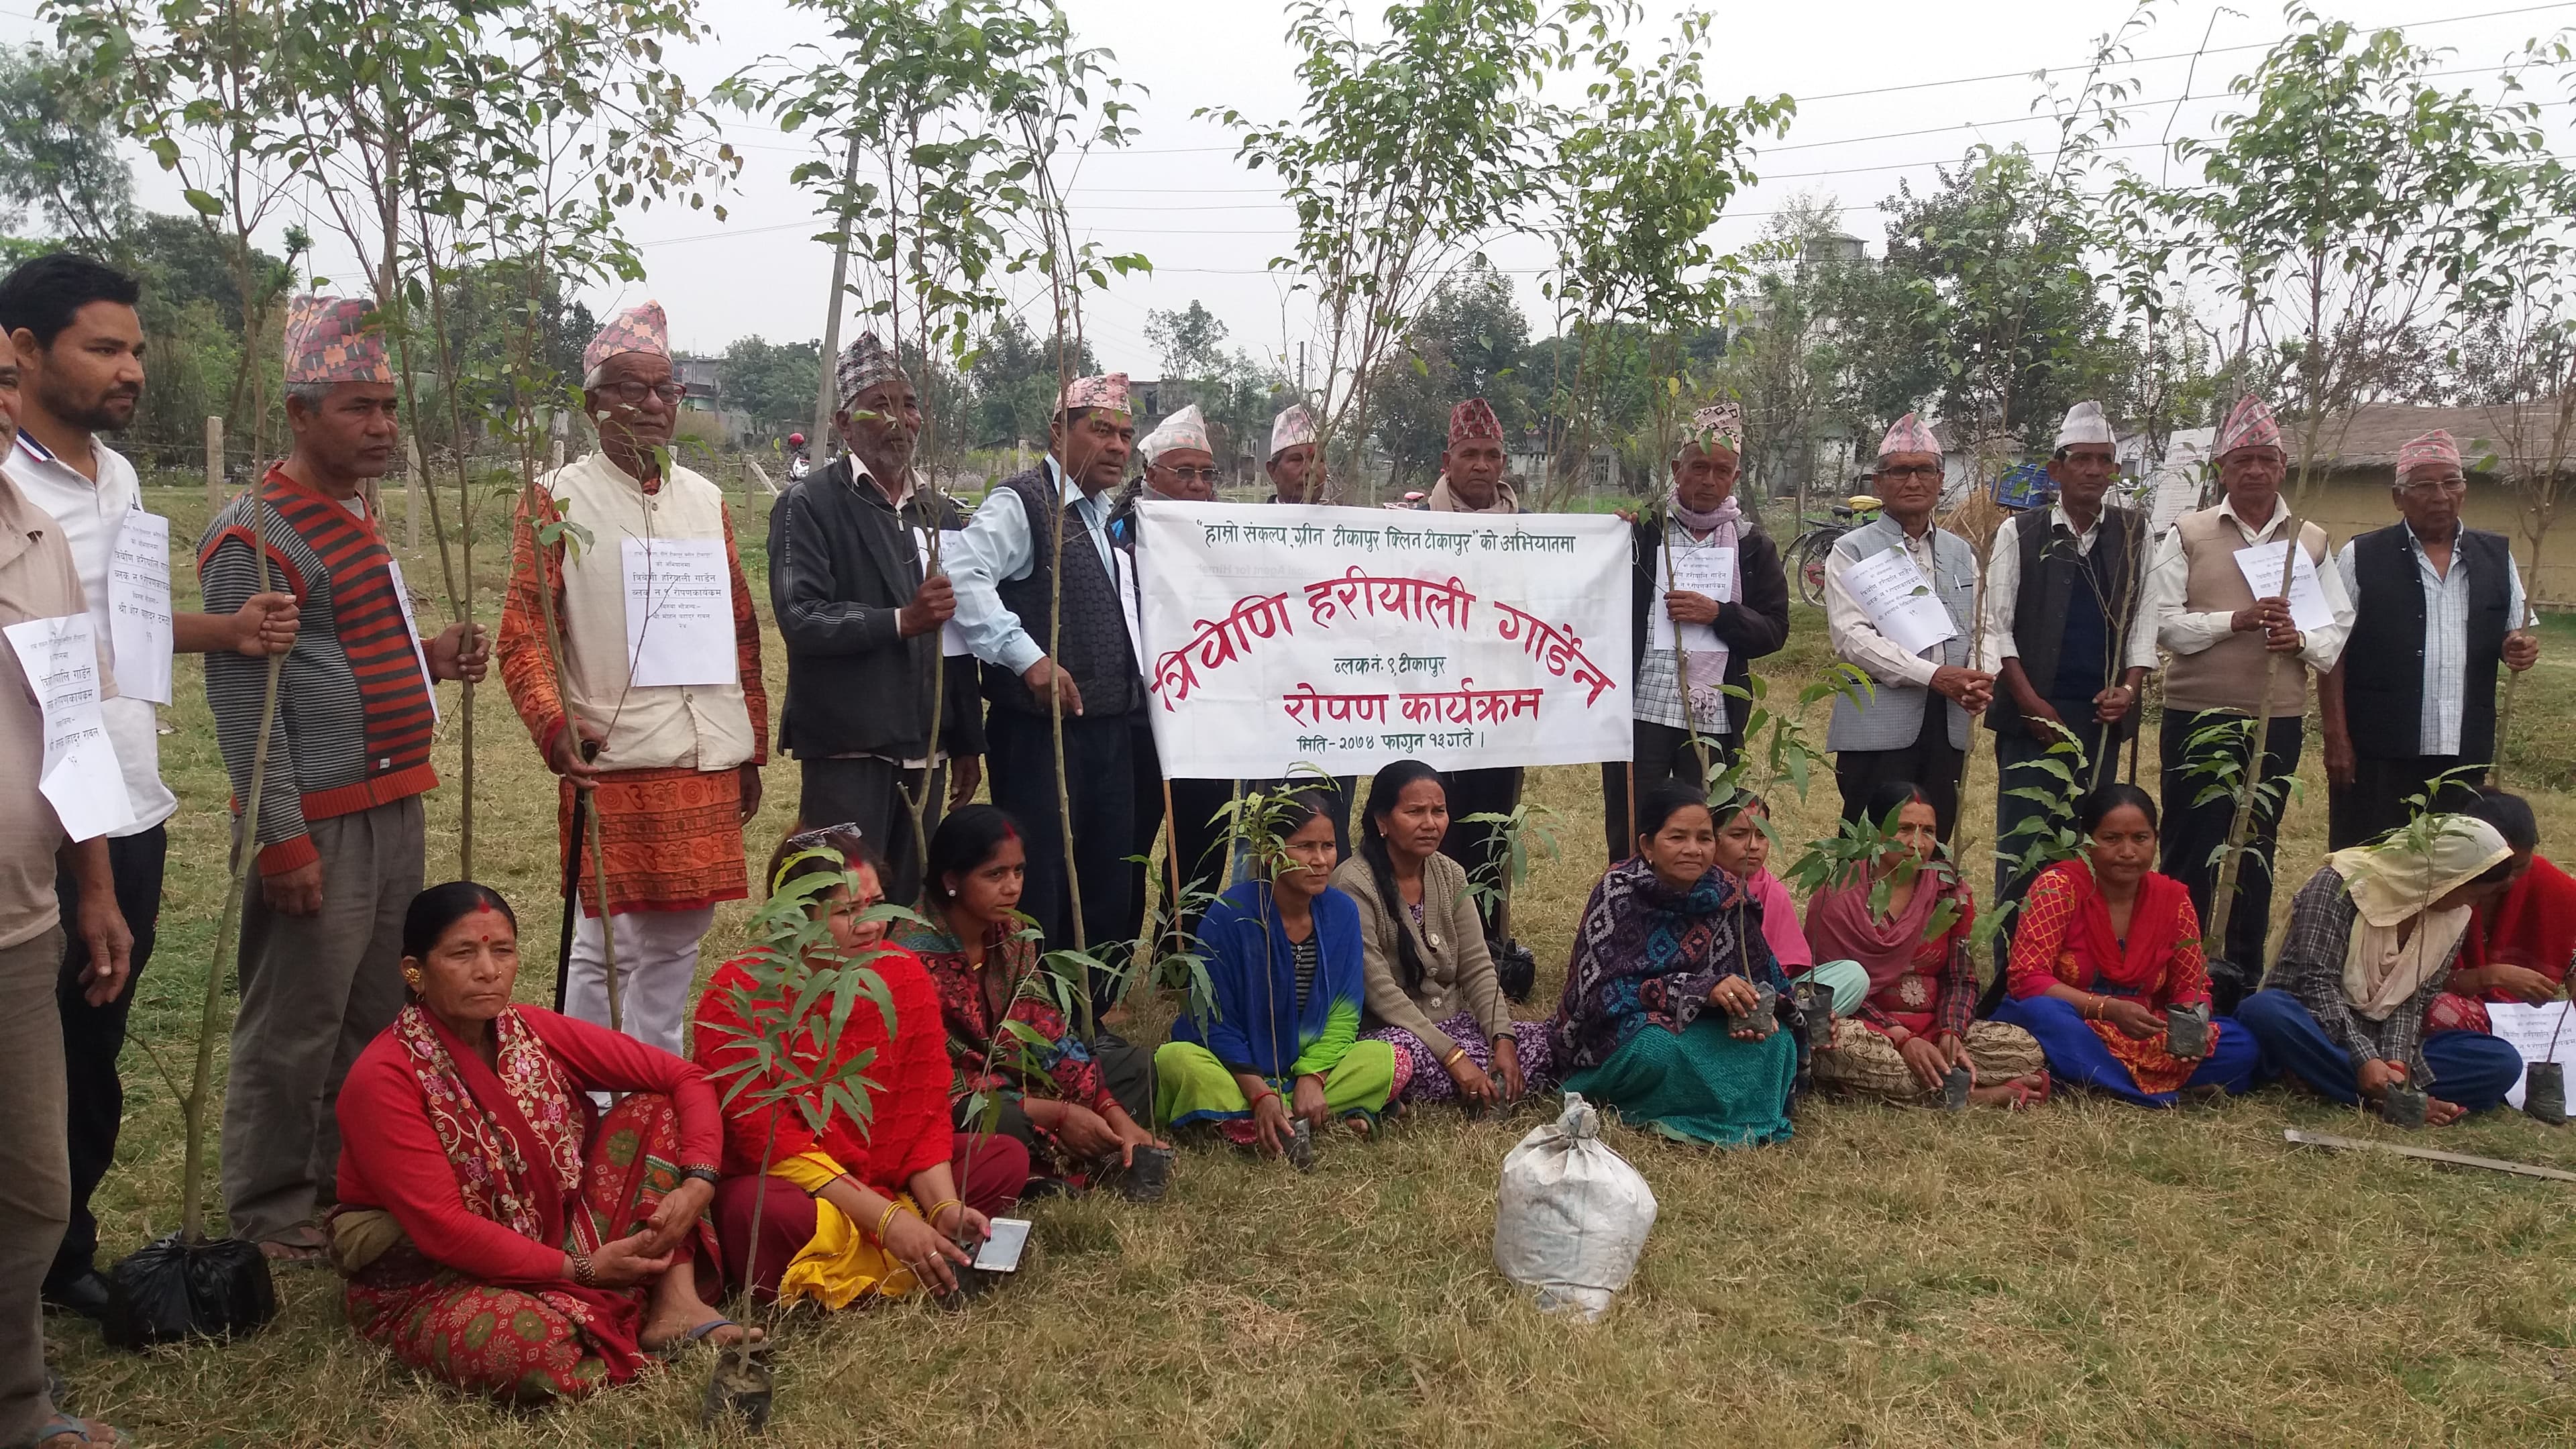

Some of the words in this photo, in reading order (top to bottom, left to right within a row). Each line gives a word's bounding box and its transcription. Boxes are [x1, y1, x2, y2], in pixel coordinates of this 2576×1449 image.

[1291, 522, 1325, 547] ग्रीन
[1332, 524, 1380, 552] टीकापुर
[1479, 529, 1499, 550] को
[1501, 531, 1576, 553] अभियानमा
[1150, 592, 1293, 712] त्रिवेणि
[1303, 565, 1477, 633] हरीयाली
[1494, 600, 1616, 709] गार्डेन
[1283, 682, 1389, 727] रोपण
[1399, 677, 1544, 726] कार्यक्रम
[1381, 733, 1426, 754] फागुन
